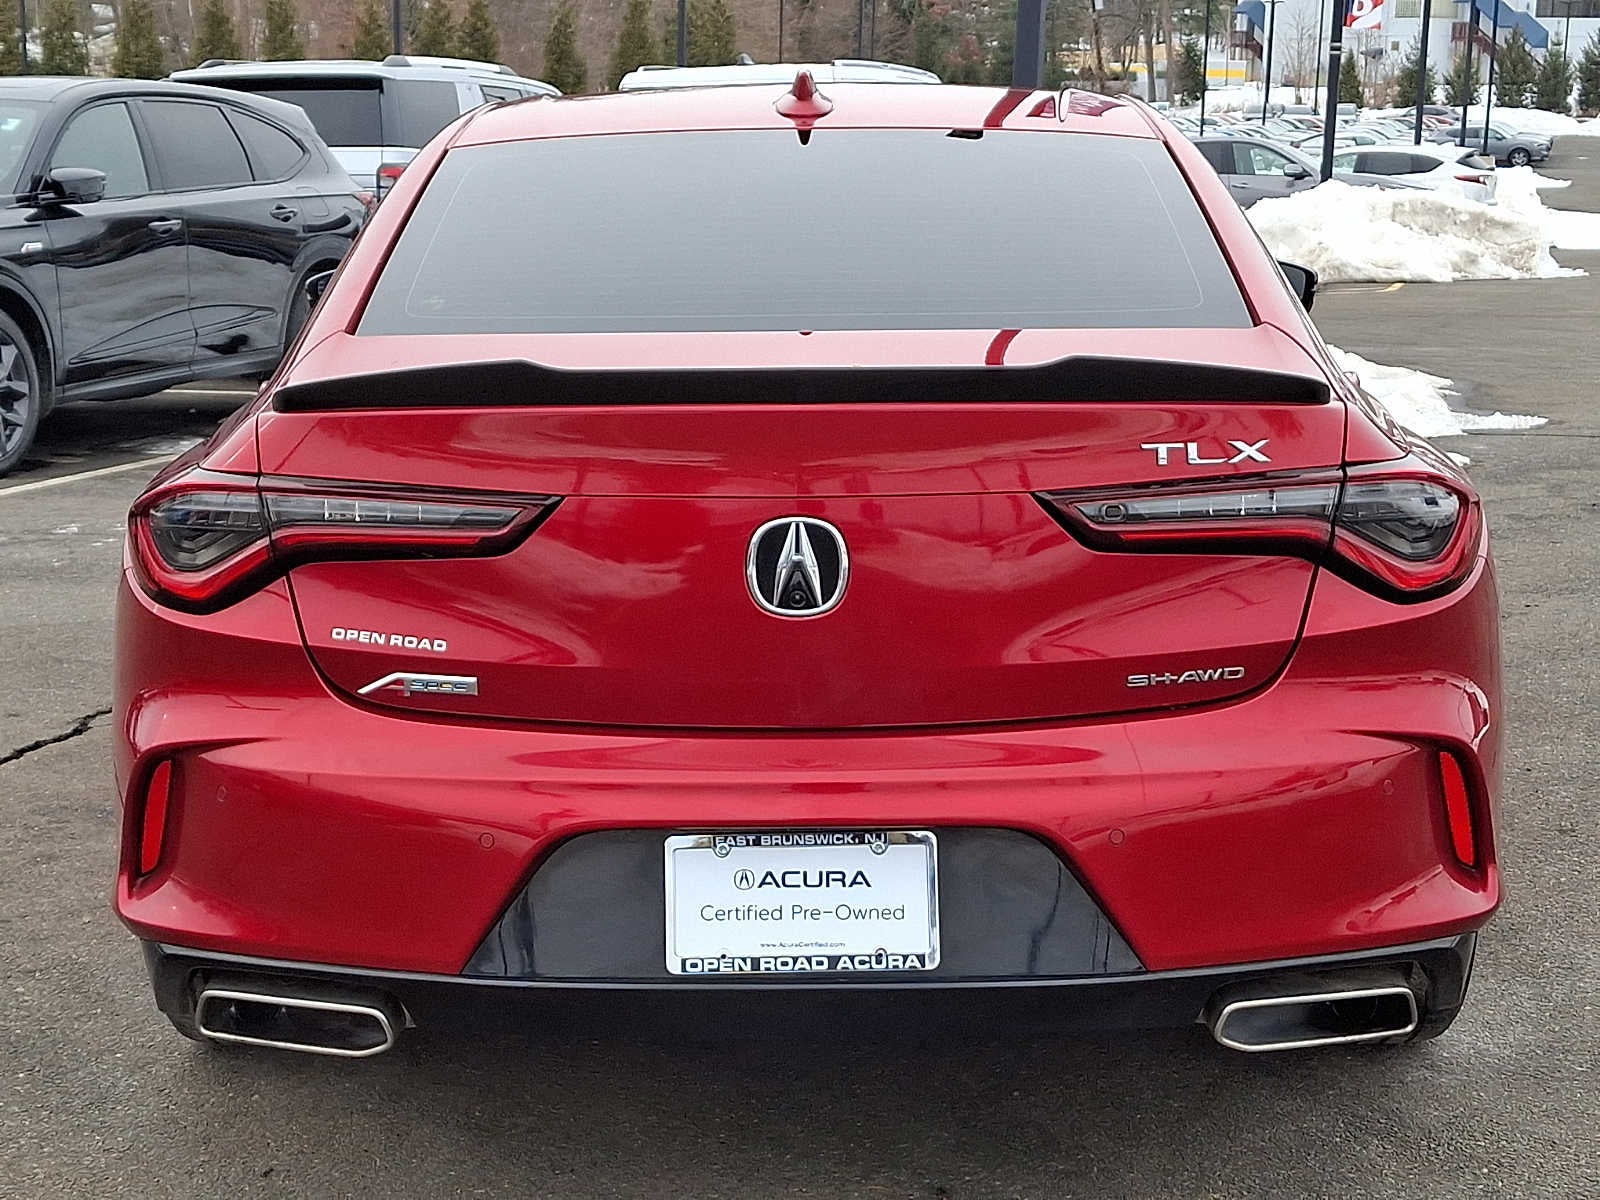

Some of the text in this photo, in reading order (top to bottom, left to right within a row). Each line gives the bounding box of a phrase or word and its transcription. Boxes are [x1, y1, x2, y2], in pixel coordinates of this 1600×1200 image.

[1140, 439, 1271, 466] TLX
[331, 627, 447, 652] OPEN ROAD
[715, 836, 756, 847] EAST
[865, 832, 886, 844] NJ
[757, 869, 872, 889] ACURA
[700, 903, 905, 922] Certified Pre-Owned
[685, 954, 922, 972] OPEN ROAD ACURA
